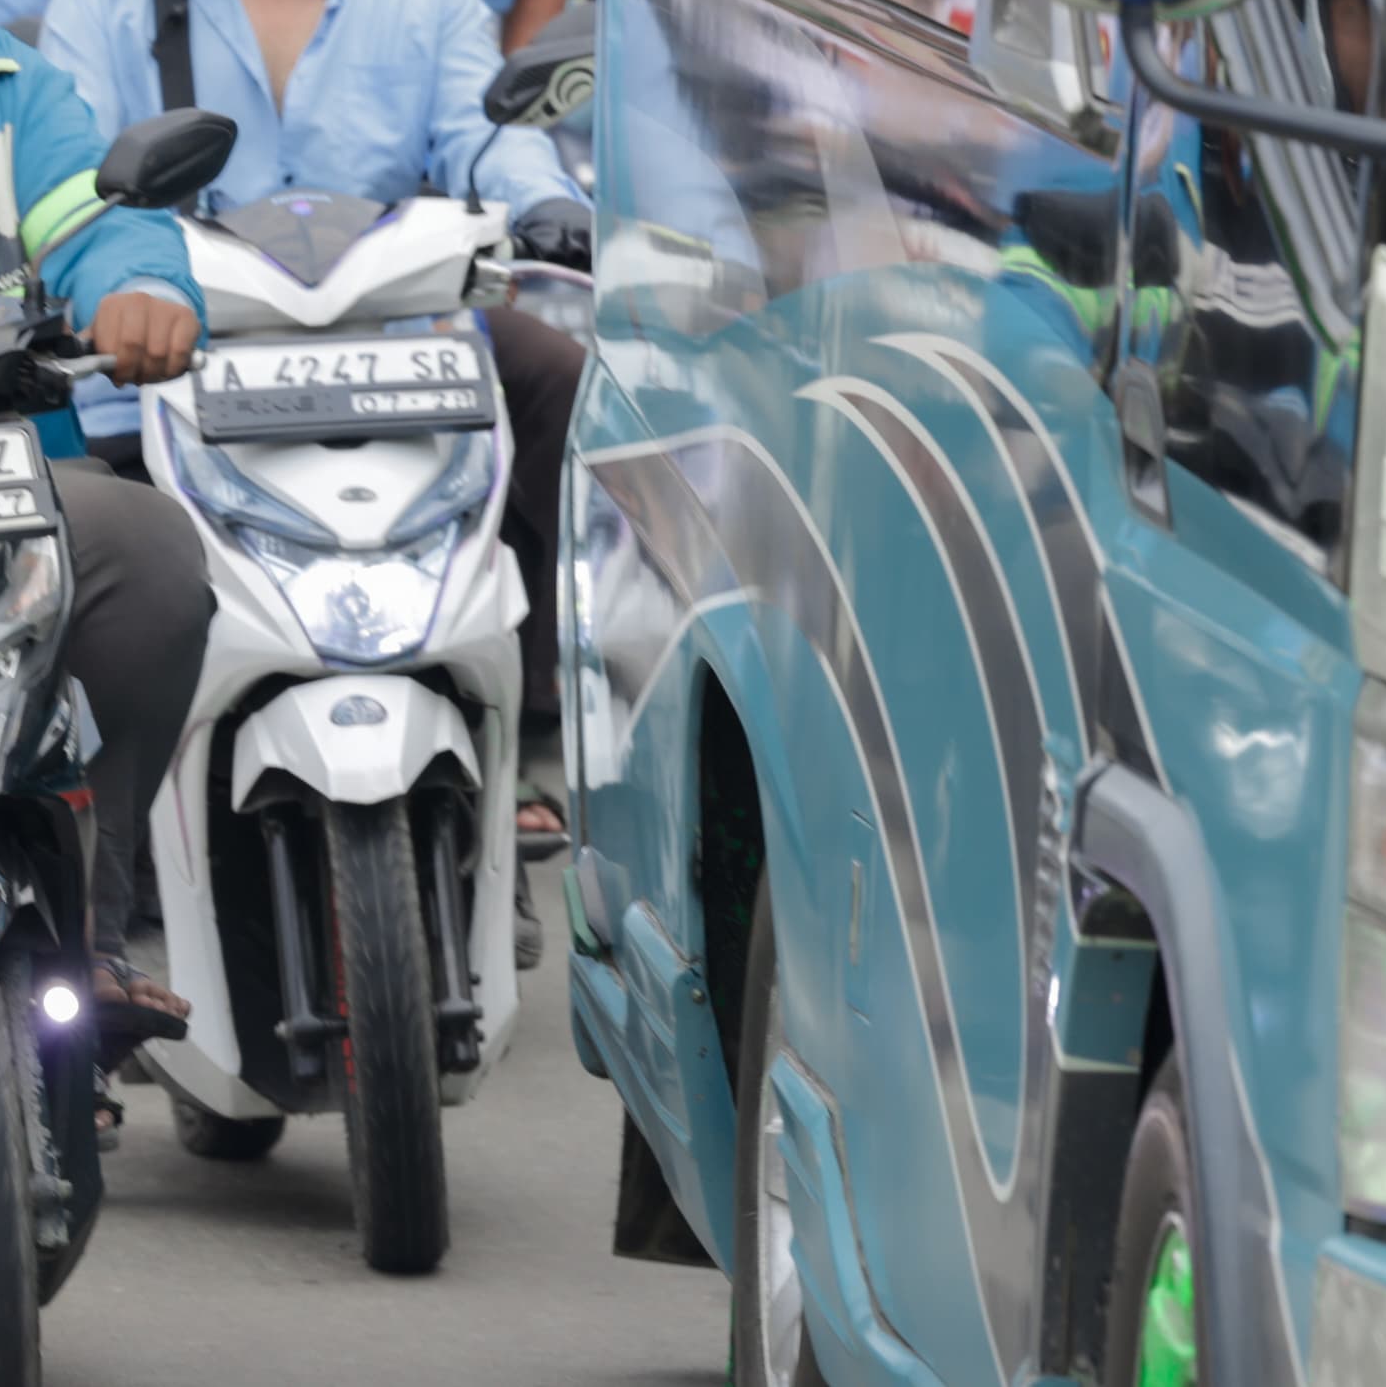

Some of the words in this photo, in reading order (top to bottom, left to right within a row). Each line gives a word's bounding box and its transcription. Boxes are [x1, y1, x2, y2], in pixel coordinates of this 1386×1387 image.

[222, 359, 244, 392] A
[274, 352, 378, 386] 4247
[410, 349, 460, 383] SR
